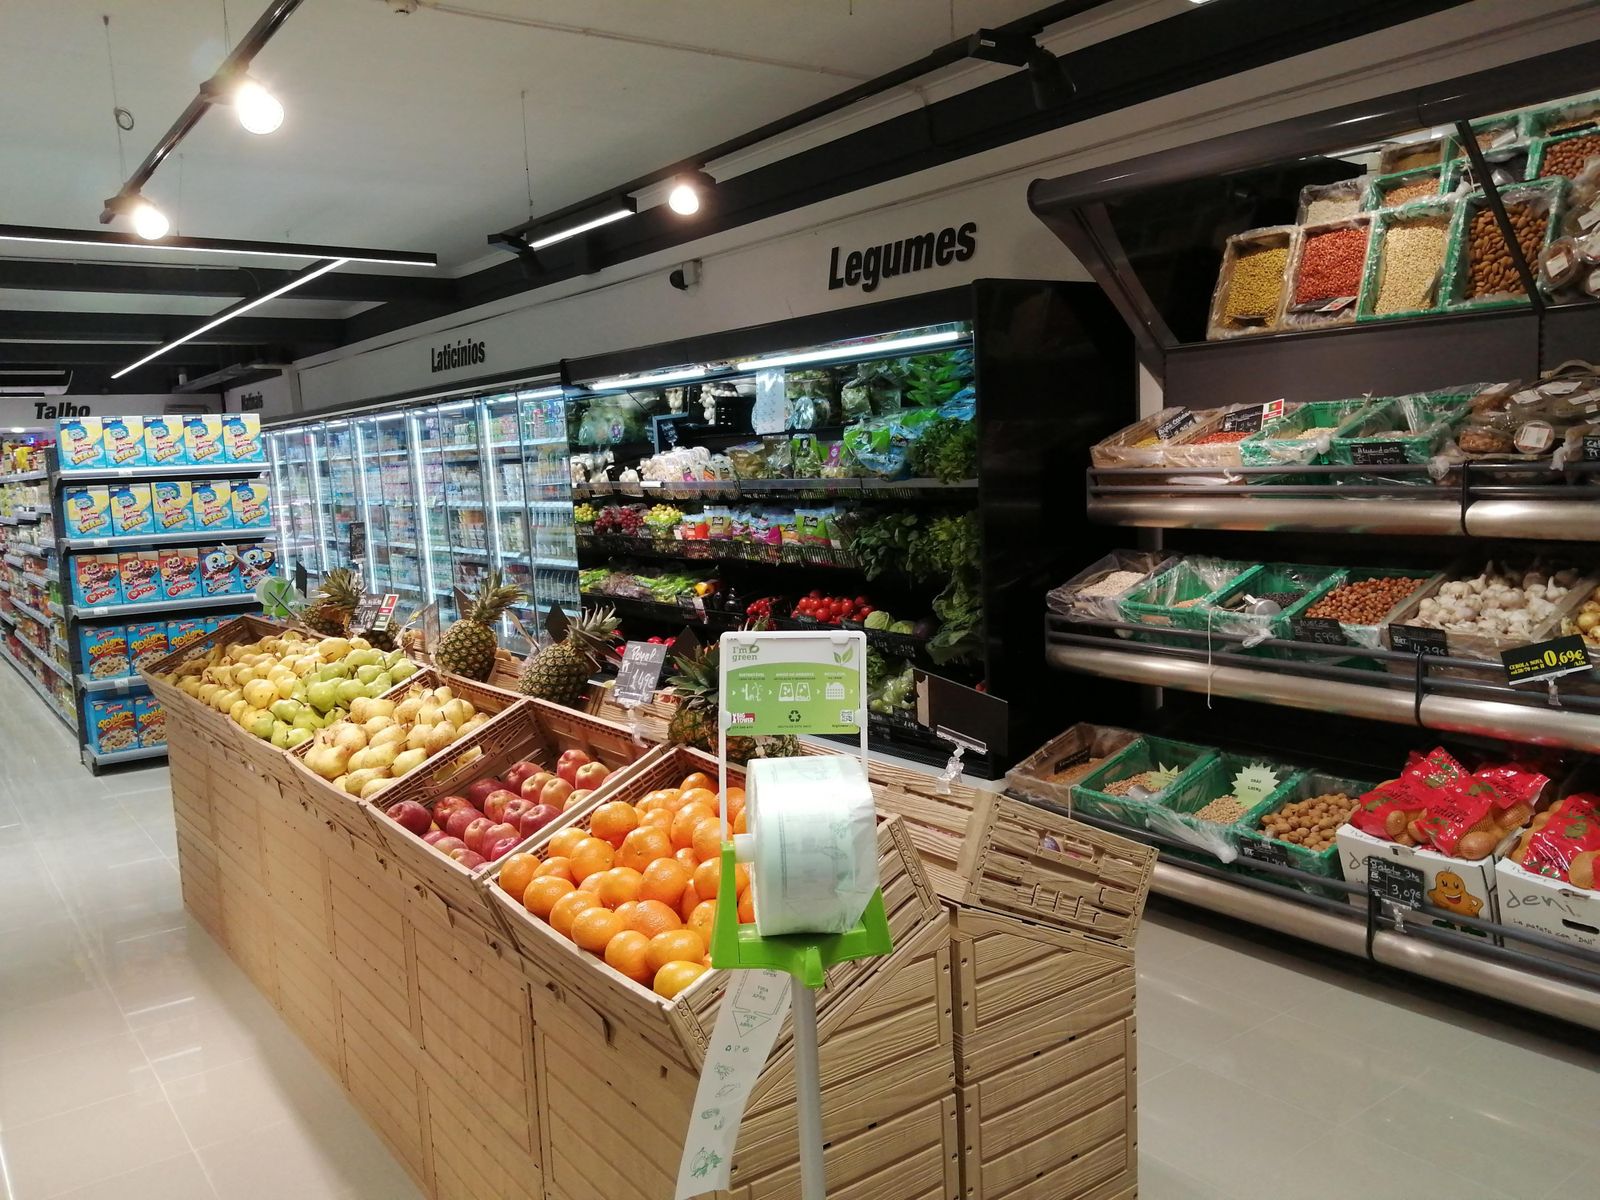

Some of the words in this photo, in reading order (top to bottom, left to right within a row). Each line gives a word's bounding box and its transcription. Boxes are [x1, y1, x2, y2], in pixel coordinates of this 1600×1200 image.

[829, 222, 977, 292] Legumes
[431, 338, 485, 373] Laticínios
[35, 402, 91, 420] Talho
[732, 646, 747, 654] I'm
[732, 654, 758, 662] green
[1543, 649, 1585, 667] 0,69€
